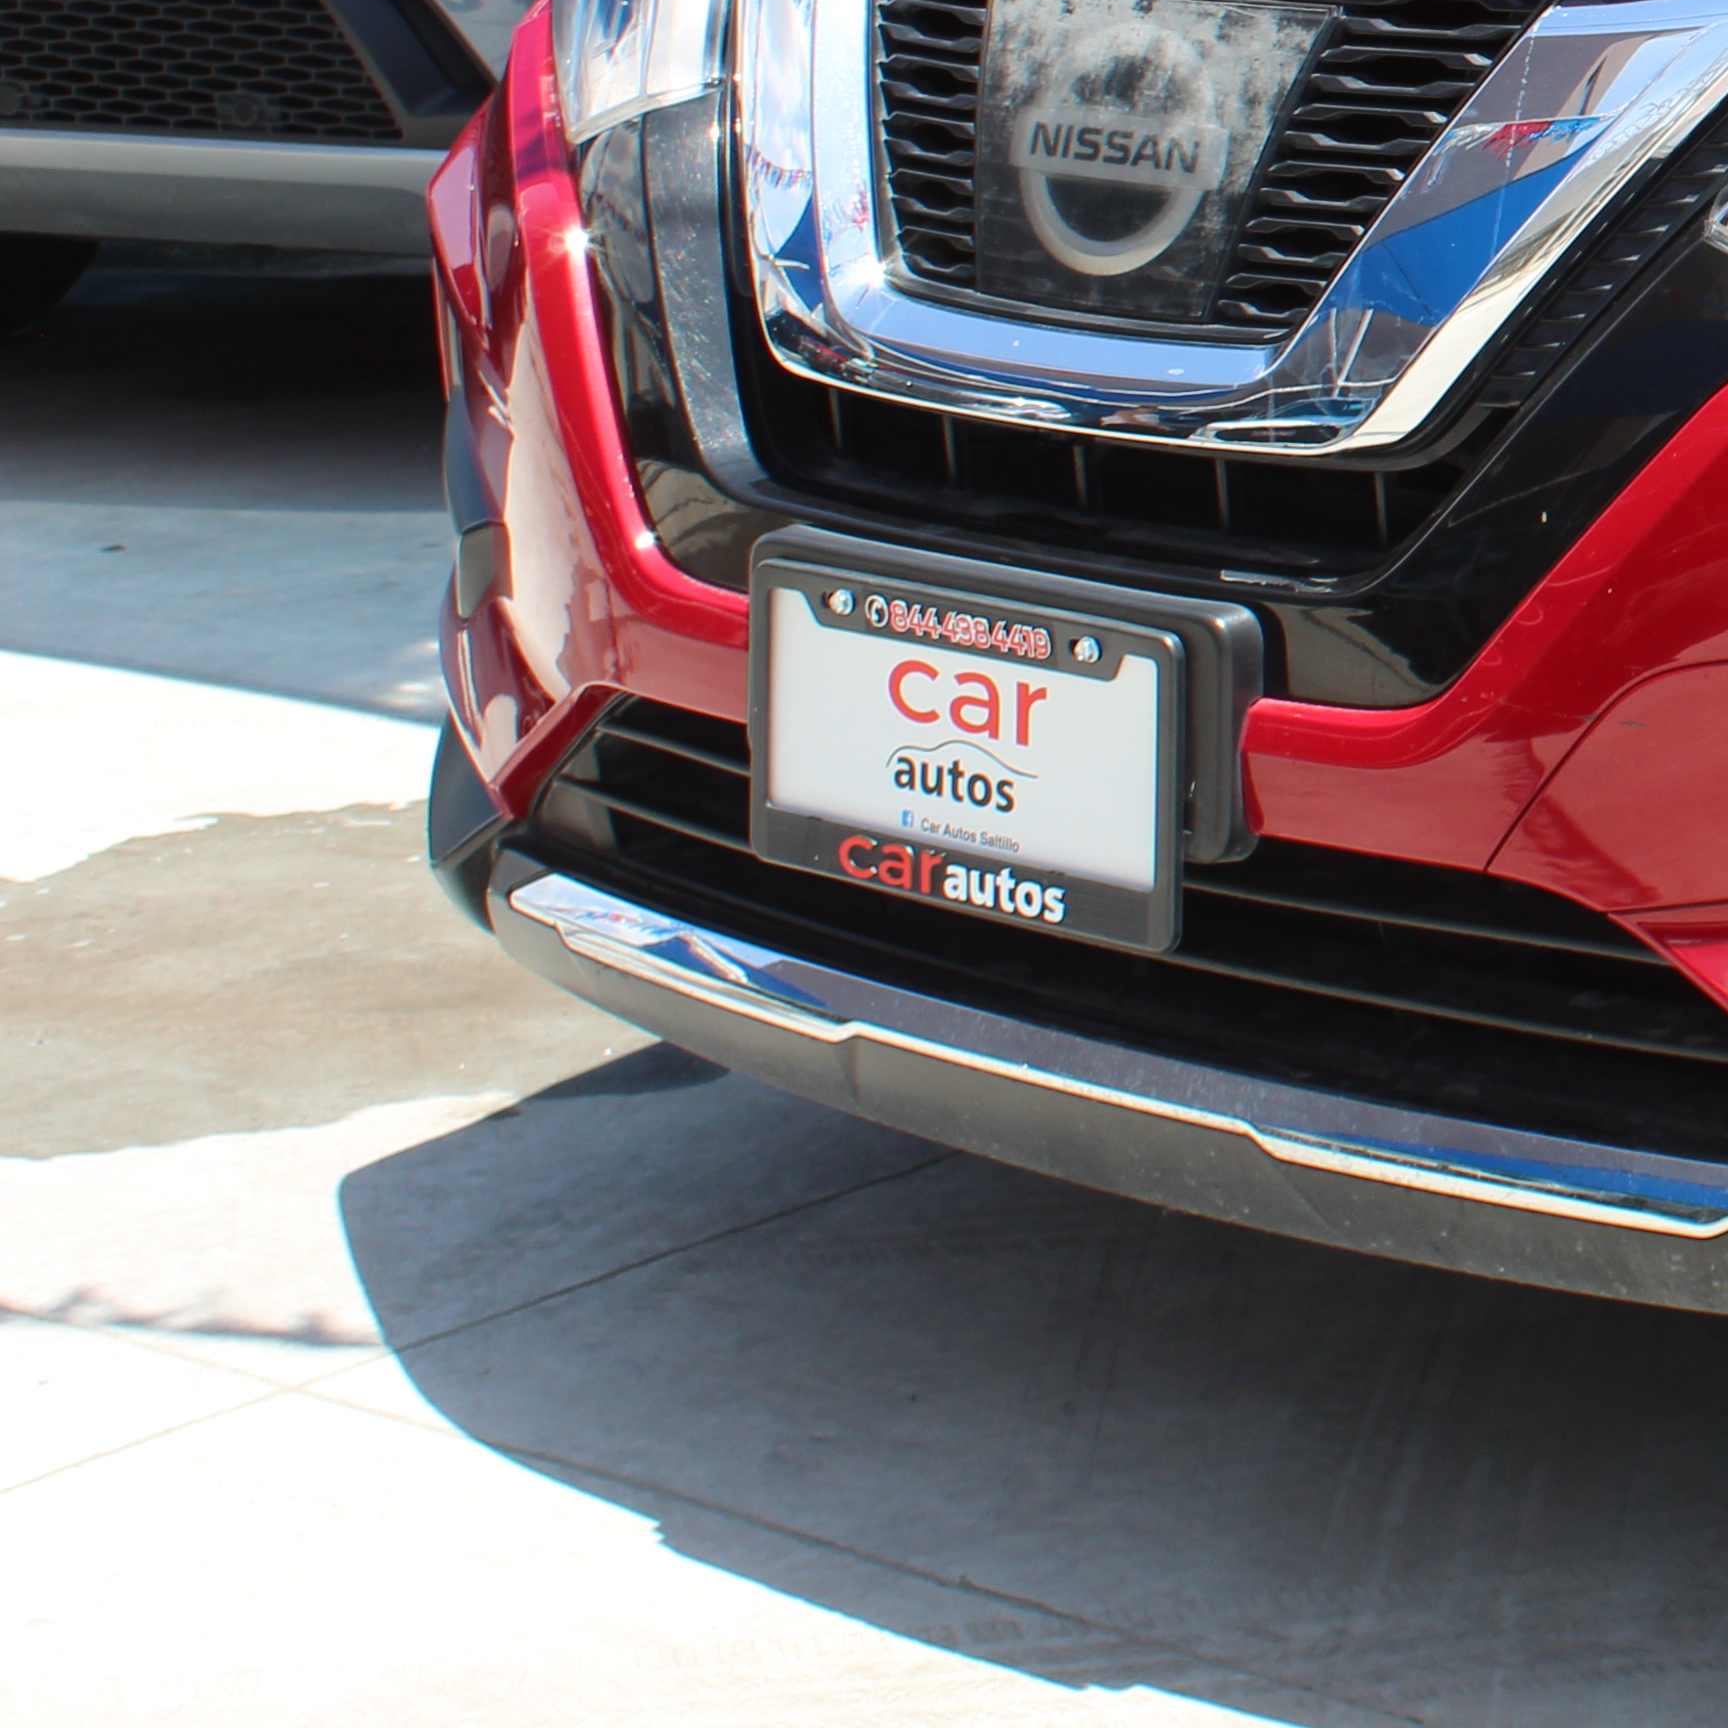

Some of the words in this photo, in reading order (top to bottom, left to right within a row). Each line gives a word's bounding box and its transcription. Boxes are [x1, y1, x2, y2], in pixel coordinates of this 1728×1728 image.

[1028, 121, 1202, 174] NISSAN
[888, 659, 1048, 747] car
[894, 756, 1016, 813] autos
[920, 817, 941, 833] Car
[943, 823, 977, 843] Autos
[980, 830, 1020, 853] Saltillo
[838, 835, 946, 894] car
[942, 863, 1066, 924] autos
